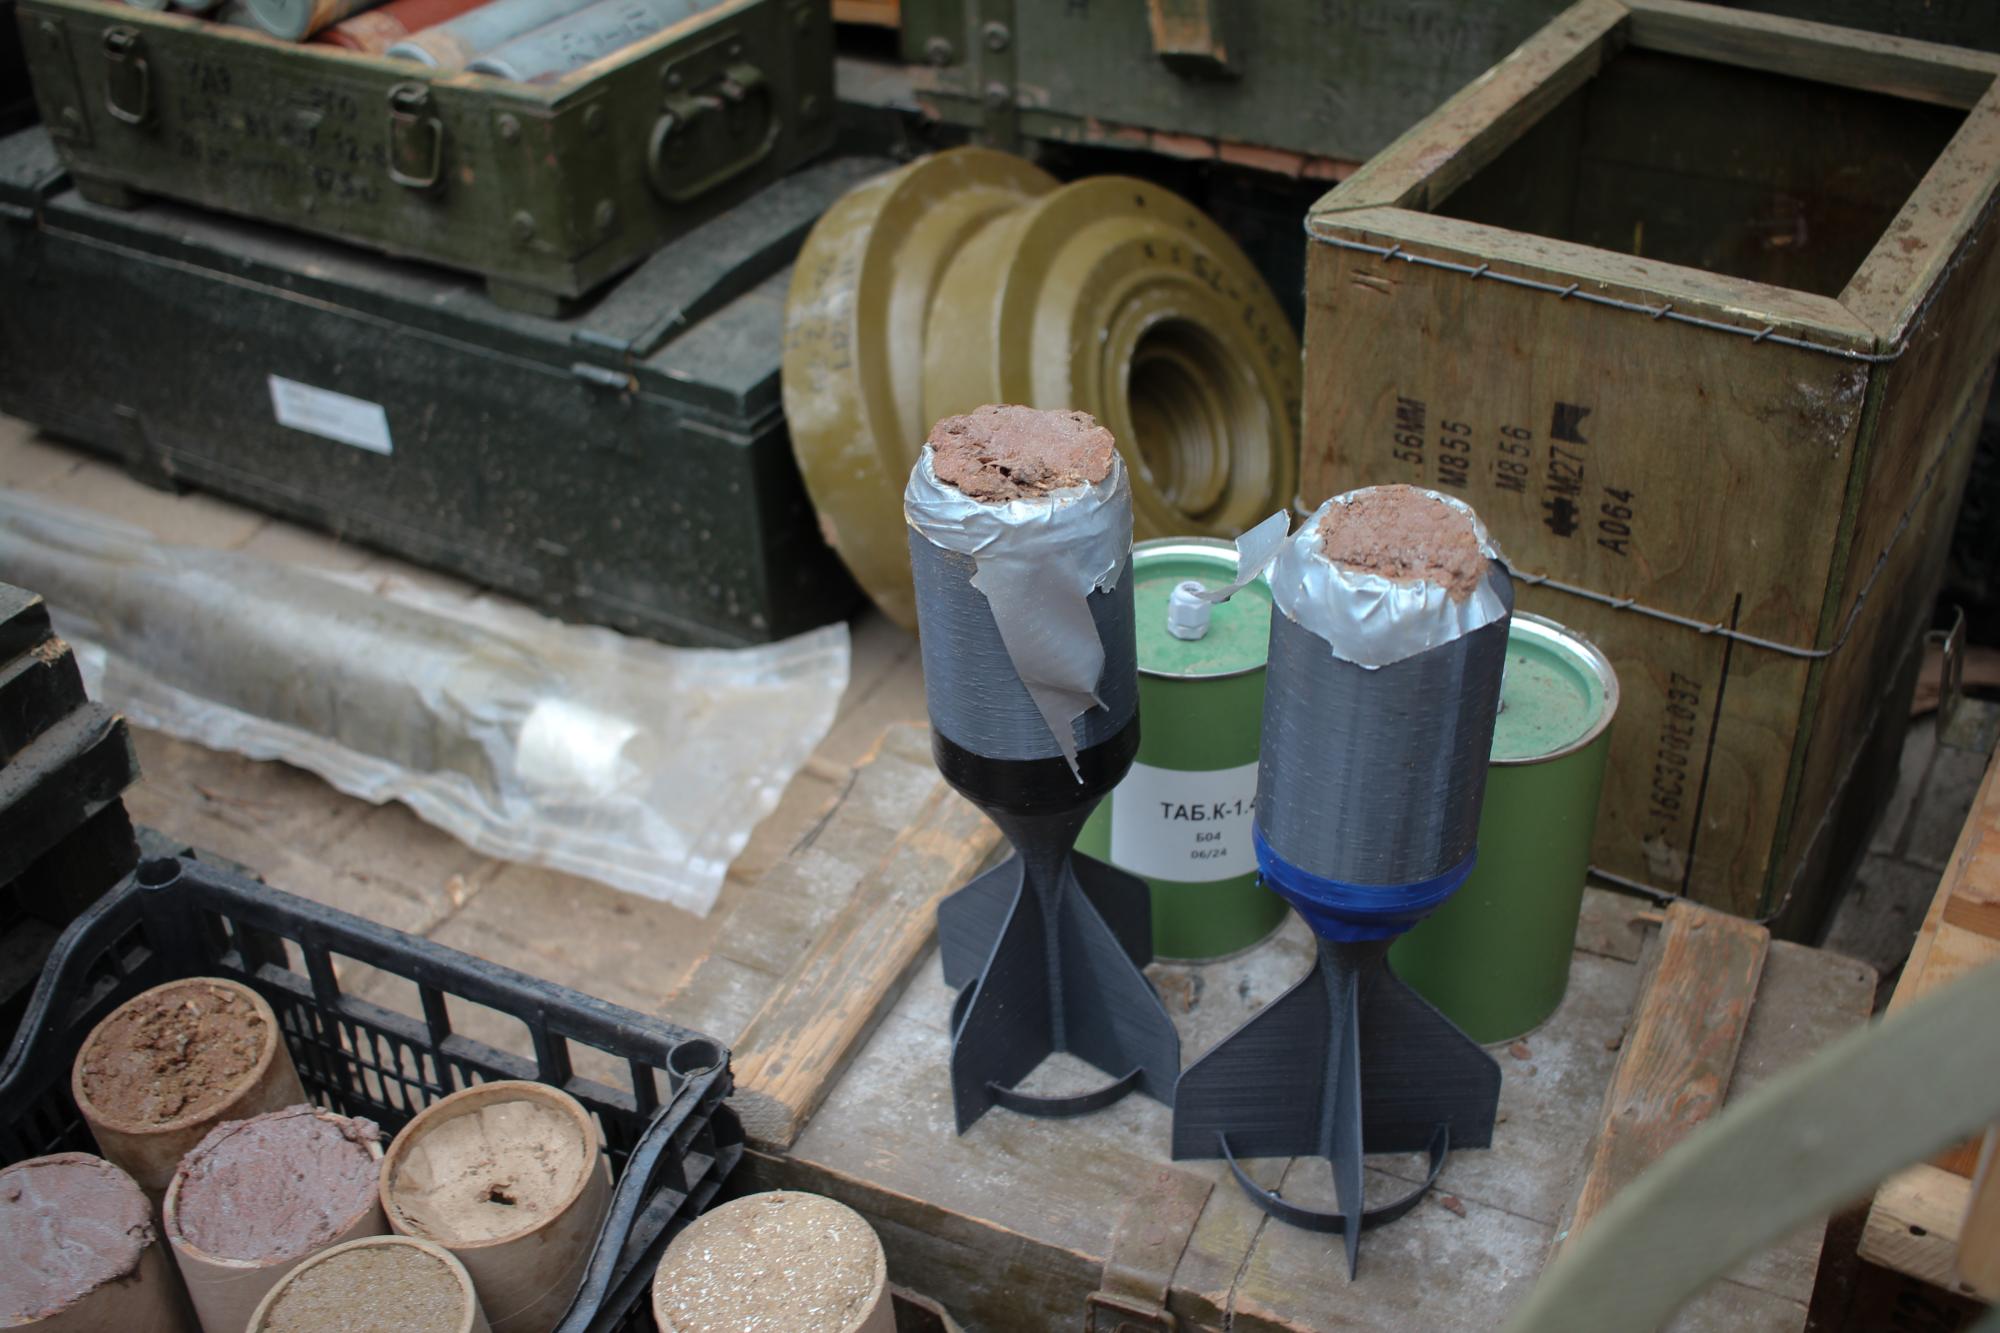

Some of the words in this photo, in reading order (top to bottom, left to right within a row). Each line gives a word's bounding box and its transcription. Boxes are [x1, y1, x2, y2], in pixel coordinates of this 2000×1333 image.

[1391, 396, 1427, 484] .56MM
[1437, 420, 1472, 490] M855
[1495, 424, 1532, 494] M856
[1546, 445, 1586, 497] M27
[1597, 487, 1635, 557] A064
[1190, 847, 1228, 860] 06/24
